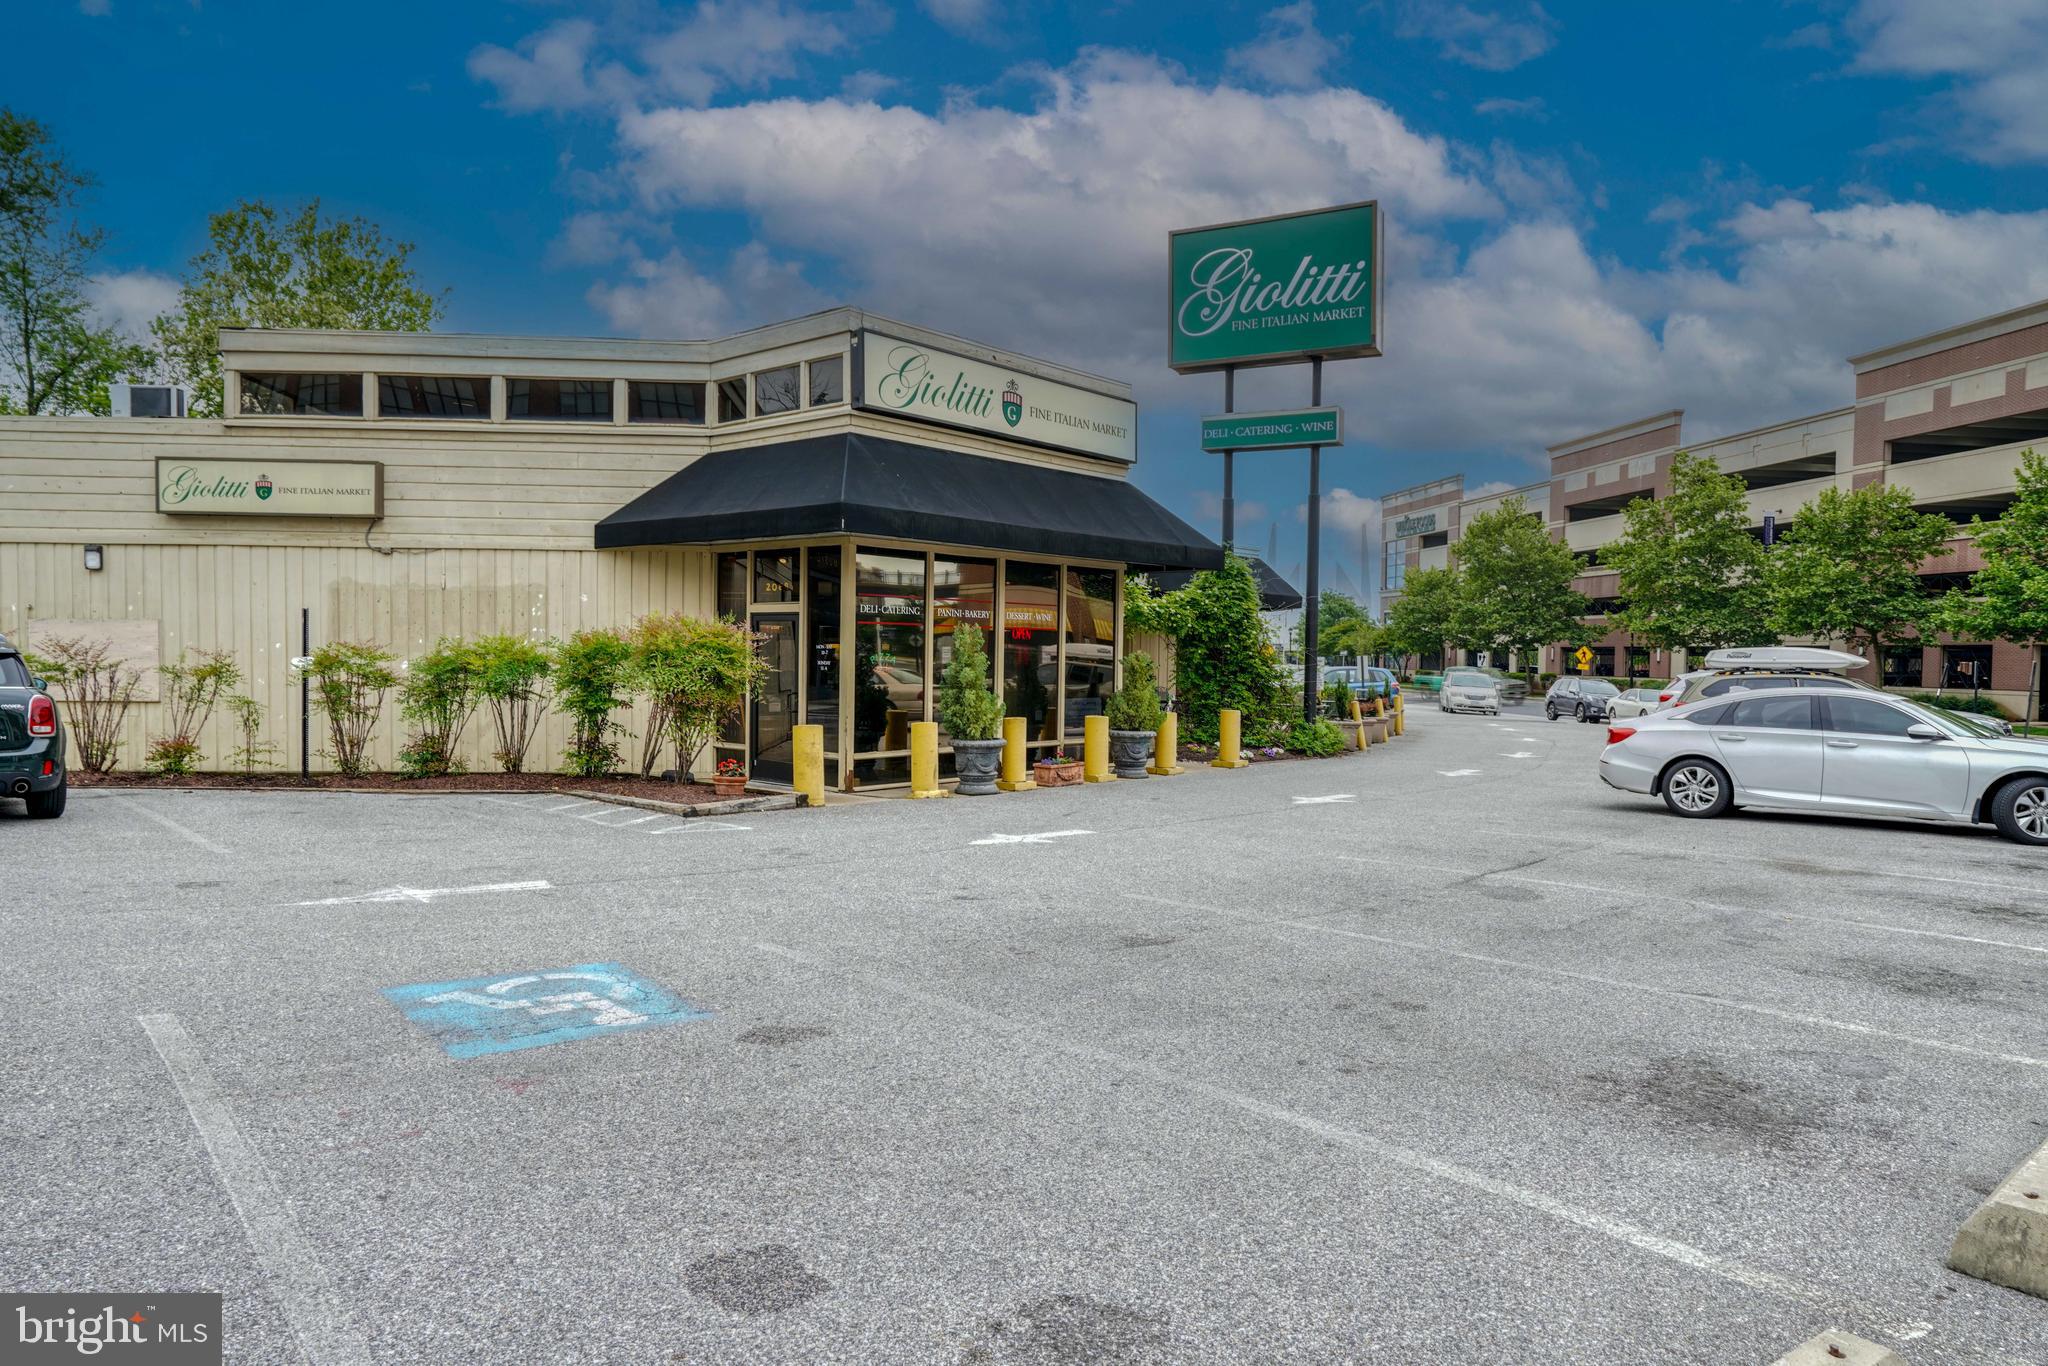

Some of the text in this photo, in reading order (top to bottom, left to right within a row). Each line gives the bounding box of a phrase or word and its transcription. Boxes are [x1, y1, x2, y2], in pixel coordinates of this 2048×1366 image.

[1178, 247, 1367, 337] Giolitti
[1231, 306, 1366, 332] FINE ITALIAN MARKET
[878, 345, 994, 419] Giolitti
[1006, 405, 1017, 422] G
[1029, 406, 1128, 439] FINE ITALIAN MARKET
[1203, 420, 1334, 440] DELI CATERING WINE
[161, 465, 249, 504] Giolitti
[278, 486, 372, 496] FINE ITALIAN MARKET
[1011, 628, 1032, 641] OPEN
